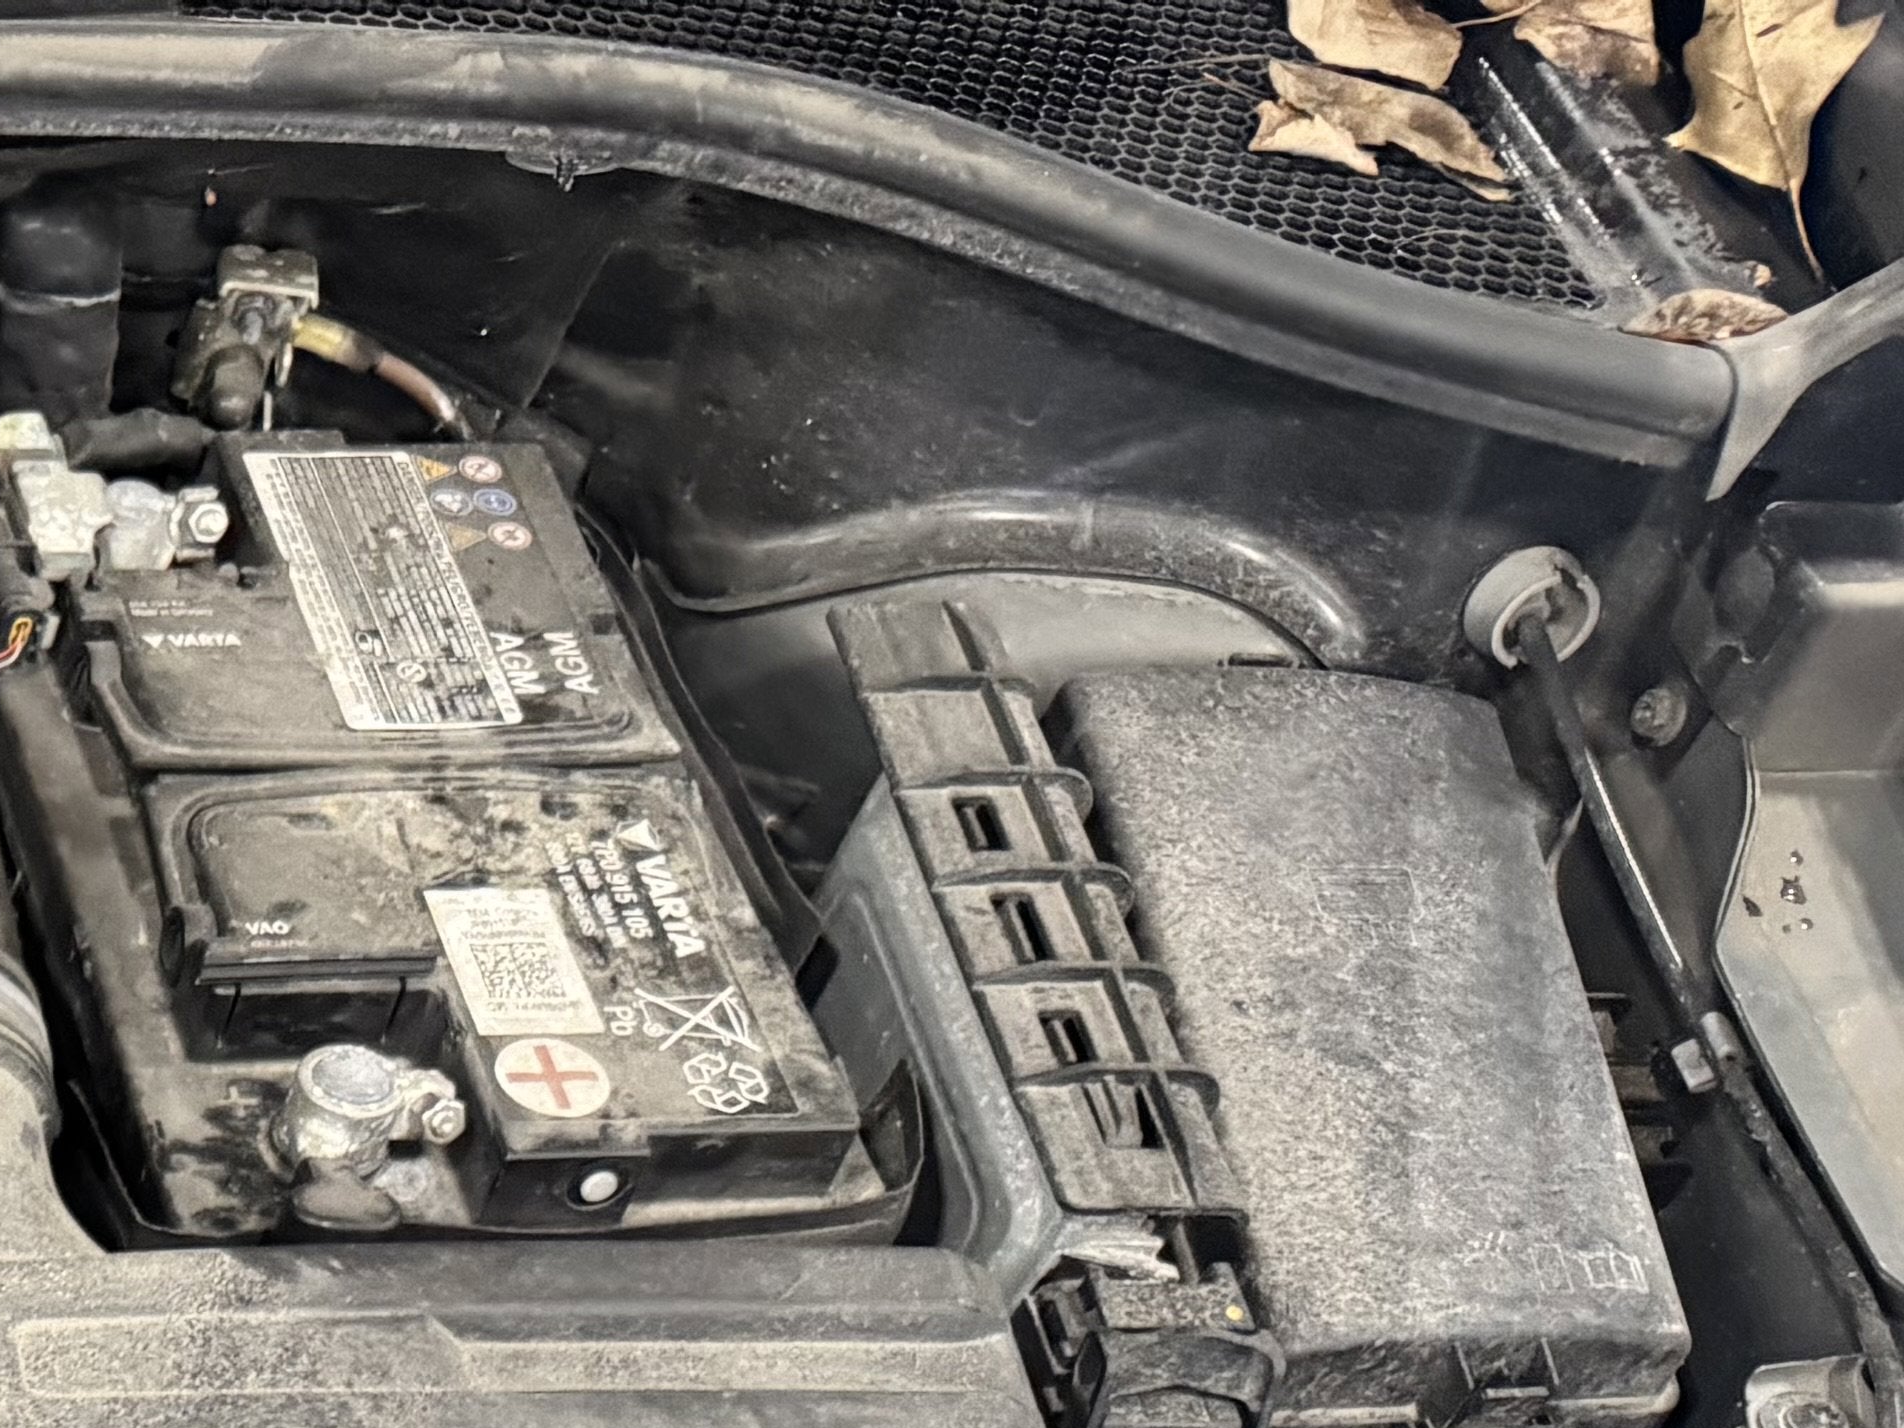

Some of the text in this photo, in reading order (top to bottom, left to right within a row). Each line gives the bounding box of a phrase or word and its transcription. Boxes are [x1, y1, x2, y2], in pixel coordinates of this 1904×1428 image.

[167, 633, 241, 647] VARTA
[490, 632, 545, 694] AGM
[543, 632, 599, 694] AGM
[605, 873, 637, 904] 915
[622, 907, 654, 938] 105
[636, 855, 705, 958] VARTA
[603, 1005, 636, 1036] Pb
